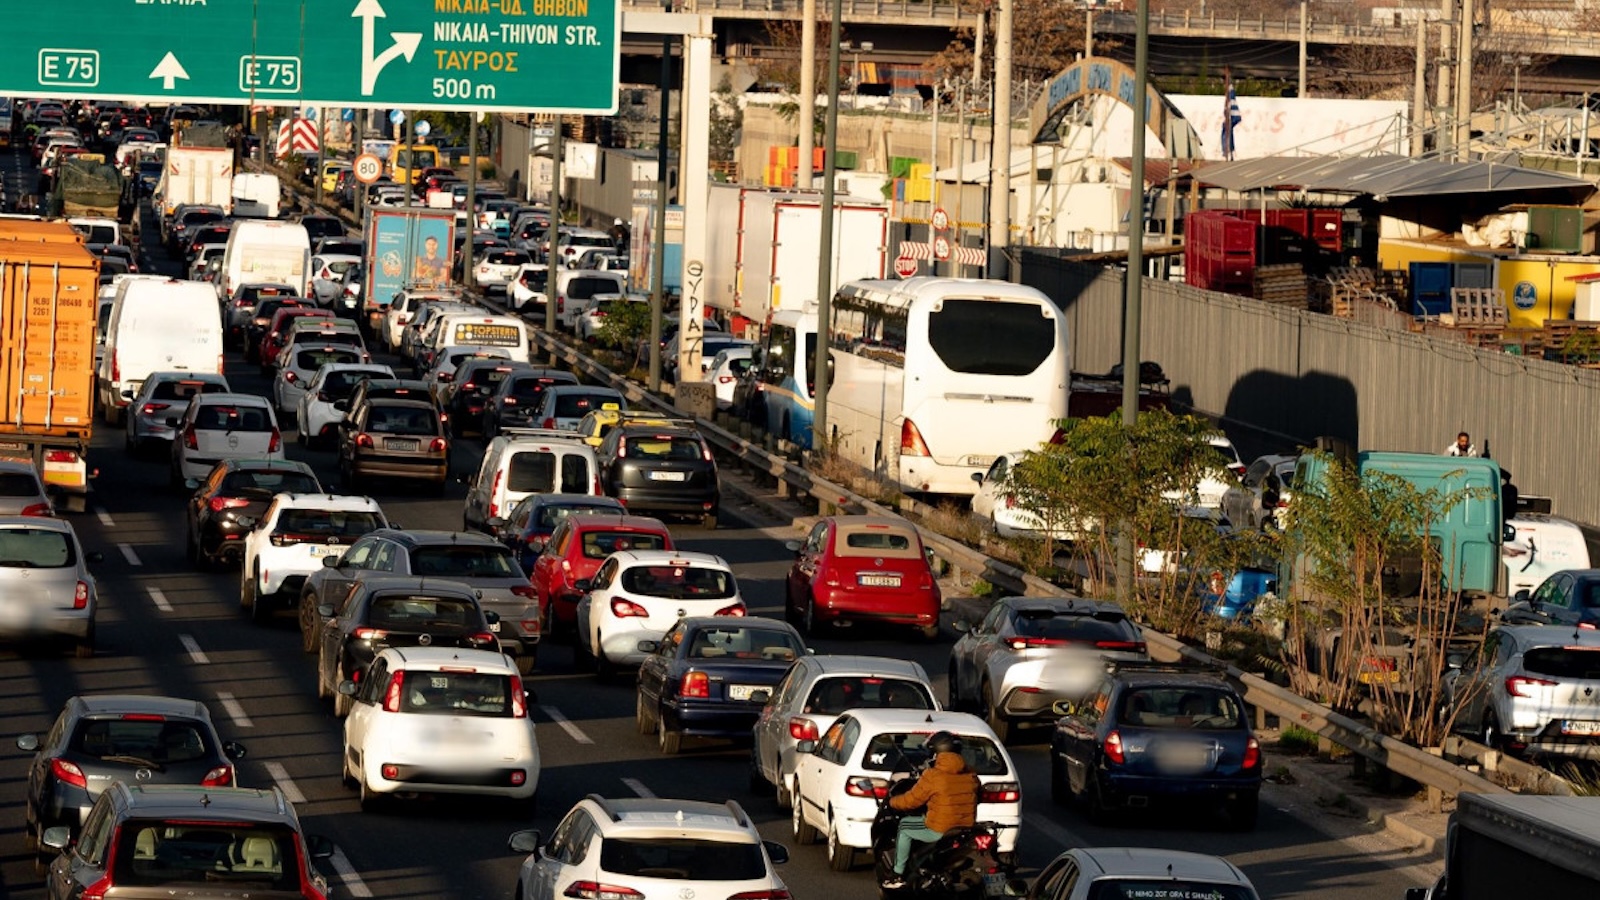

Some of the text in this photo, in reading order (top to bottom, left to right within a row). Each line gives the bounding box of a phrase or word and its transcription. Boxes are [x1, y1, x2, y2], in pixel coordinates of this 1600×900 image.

[533, 0, 588, 17] ΘΗΒΩΝ
[433, 22, 602, 46] NIKAIA-THIVON STR.
[44, 56, 94, 79] E 75
[434, 50, 519, 72] ΤΑΥΡΟΣ
[245, 63, 295, 86] E 75
[432, 78, 496, 100] 500 m
[360, 162, 376, 174] 80
[896, 261, 916, 271] STOP
[33, 297, 50, 306] HLBU
[472, 326, 518, 336] TOPSTERN
